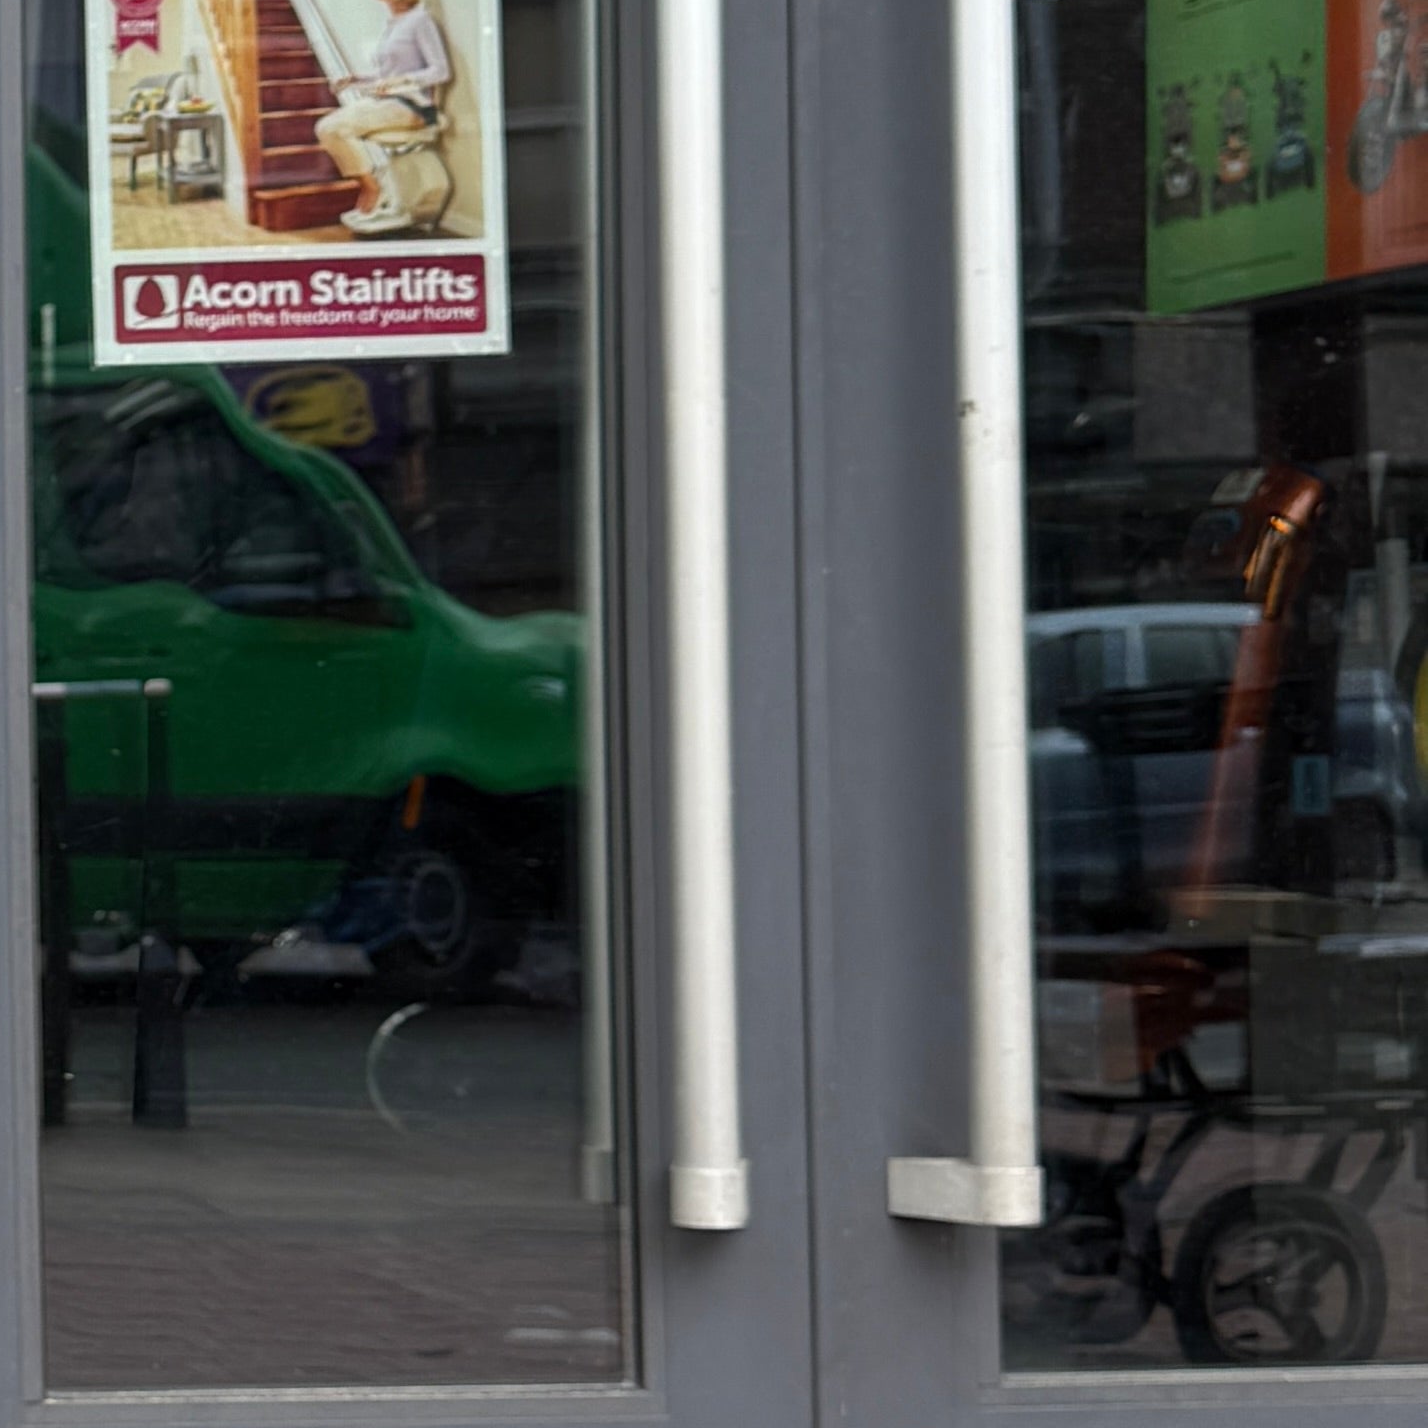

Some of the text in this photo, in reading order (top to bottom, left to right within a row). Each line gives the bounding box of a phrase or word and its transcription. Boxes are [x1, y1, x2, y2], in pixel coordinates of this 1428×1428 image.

[183, 267, 479, 310] Acorn Stairlifts
[183, 310, 244, 333] Regain
[246, 308, 276, 327] the
[279, 307, 354, 328] freedom
[423, 304, 478, 322] home
